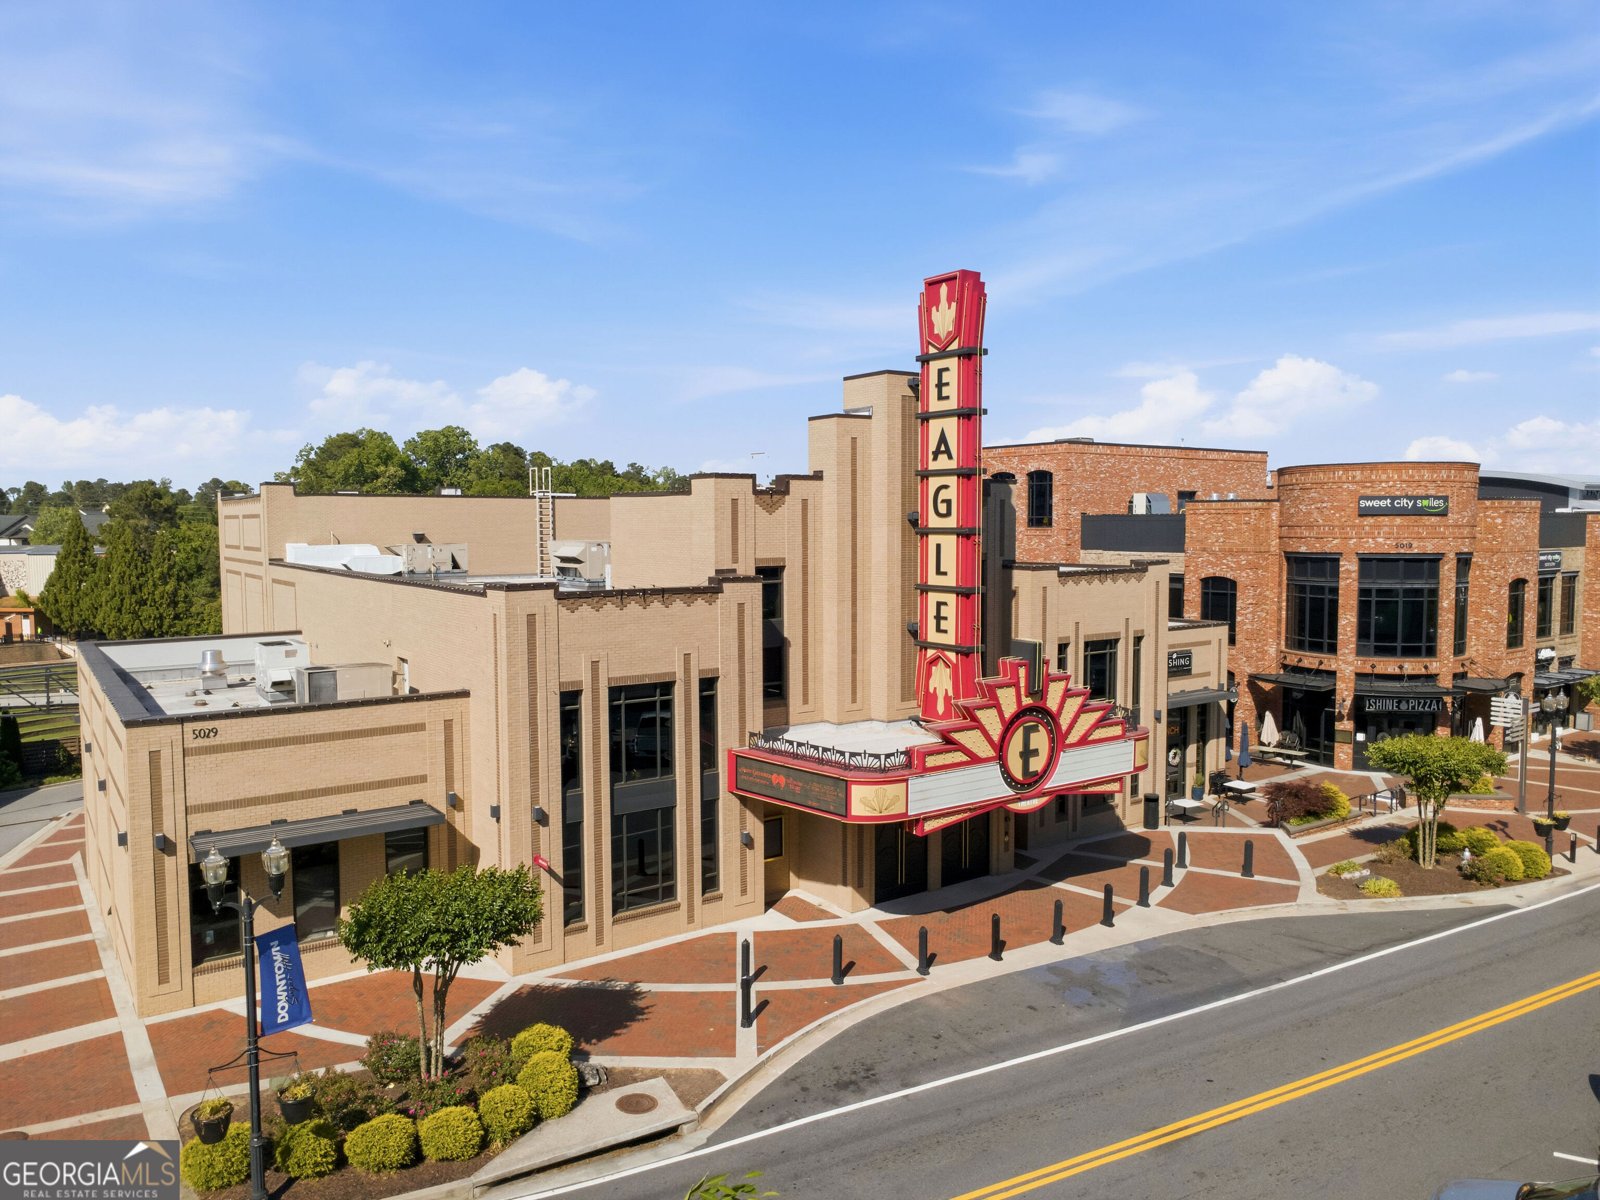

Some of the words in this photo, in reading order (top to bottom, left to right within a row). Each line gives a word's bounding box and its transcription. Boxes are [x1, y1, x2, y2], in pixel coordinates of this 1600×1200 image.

[931, 366, 954, 635] EAGLE
[1359, 498, 1392, 507] sweet
[1394, 498, 1413, 509] city
[1168, 657, 1190, 667] SHING
[1370, 699, 1399, 711] SHINE
[1408, 700, 1438, 712] PIZZA
[192, 727, 218, 740] 5029
[1018, 724, 1041, 779] E
[269, 940, 289, 1024] DOWNTOWN
